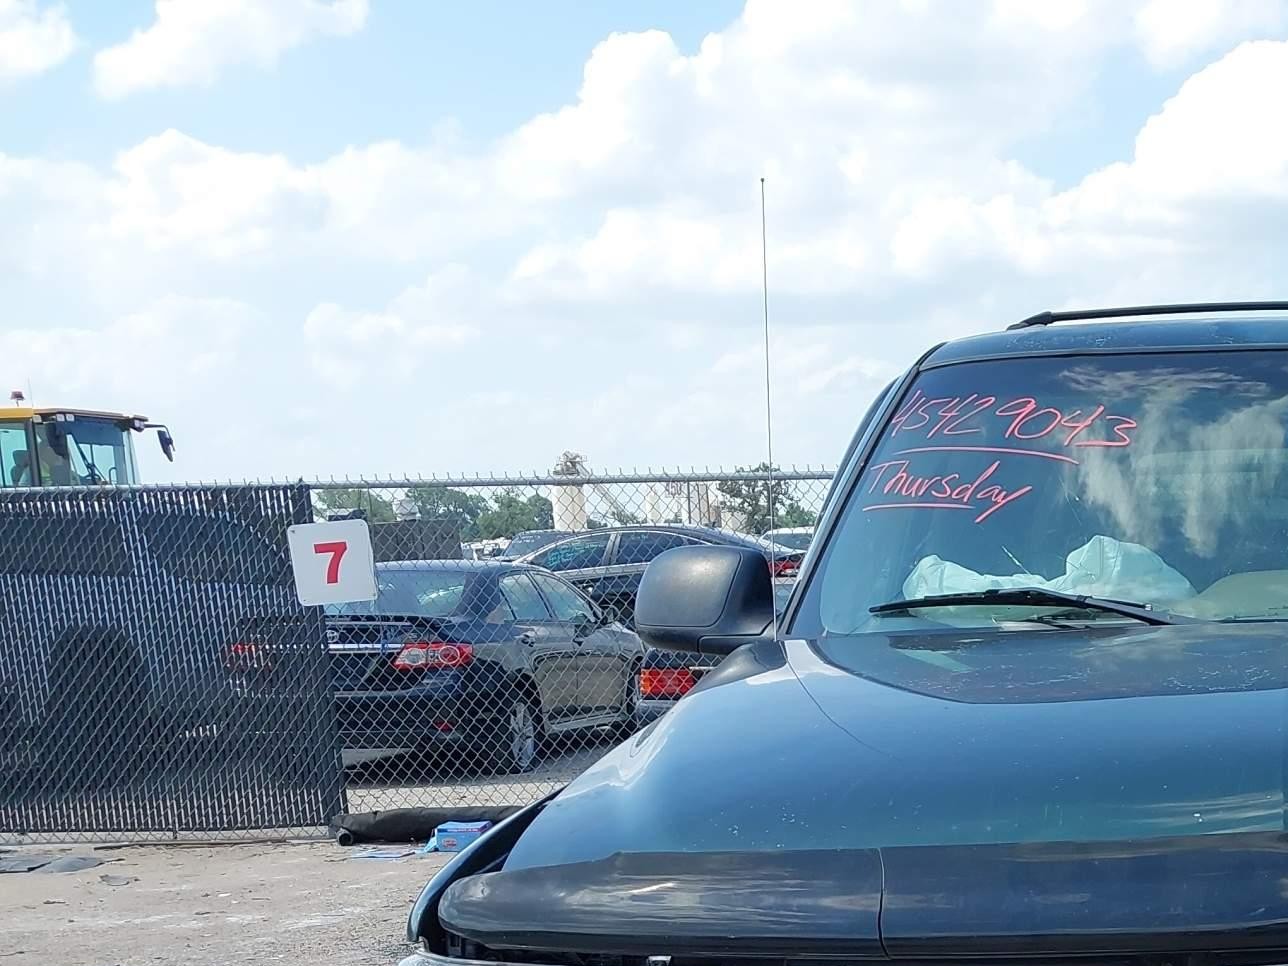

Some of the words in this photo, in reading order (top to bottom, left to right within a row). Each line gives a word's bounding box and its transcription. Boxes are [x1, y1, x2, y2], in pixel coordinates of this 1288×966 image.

[891, 390, 1137, 446] 45429043
[869, 459, 1033, 523] Thursday
[313, 541, 348, 584] 7
